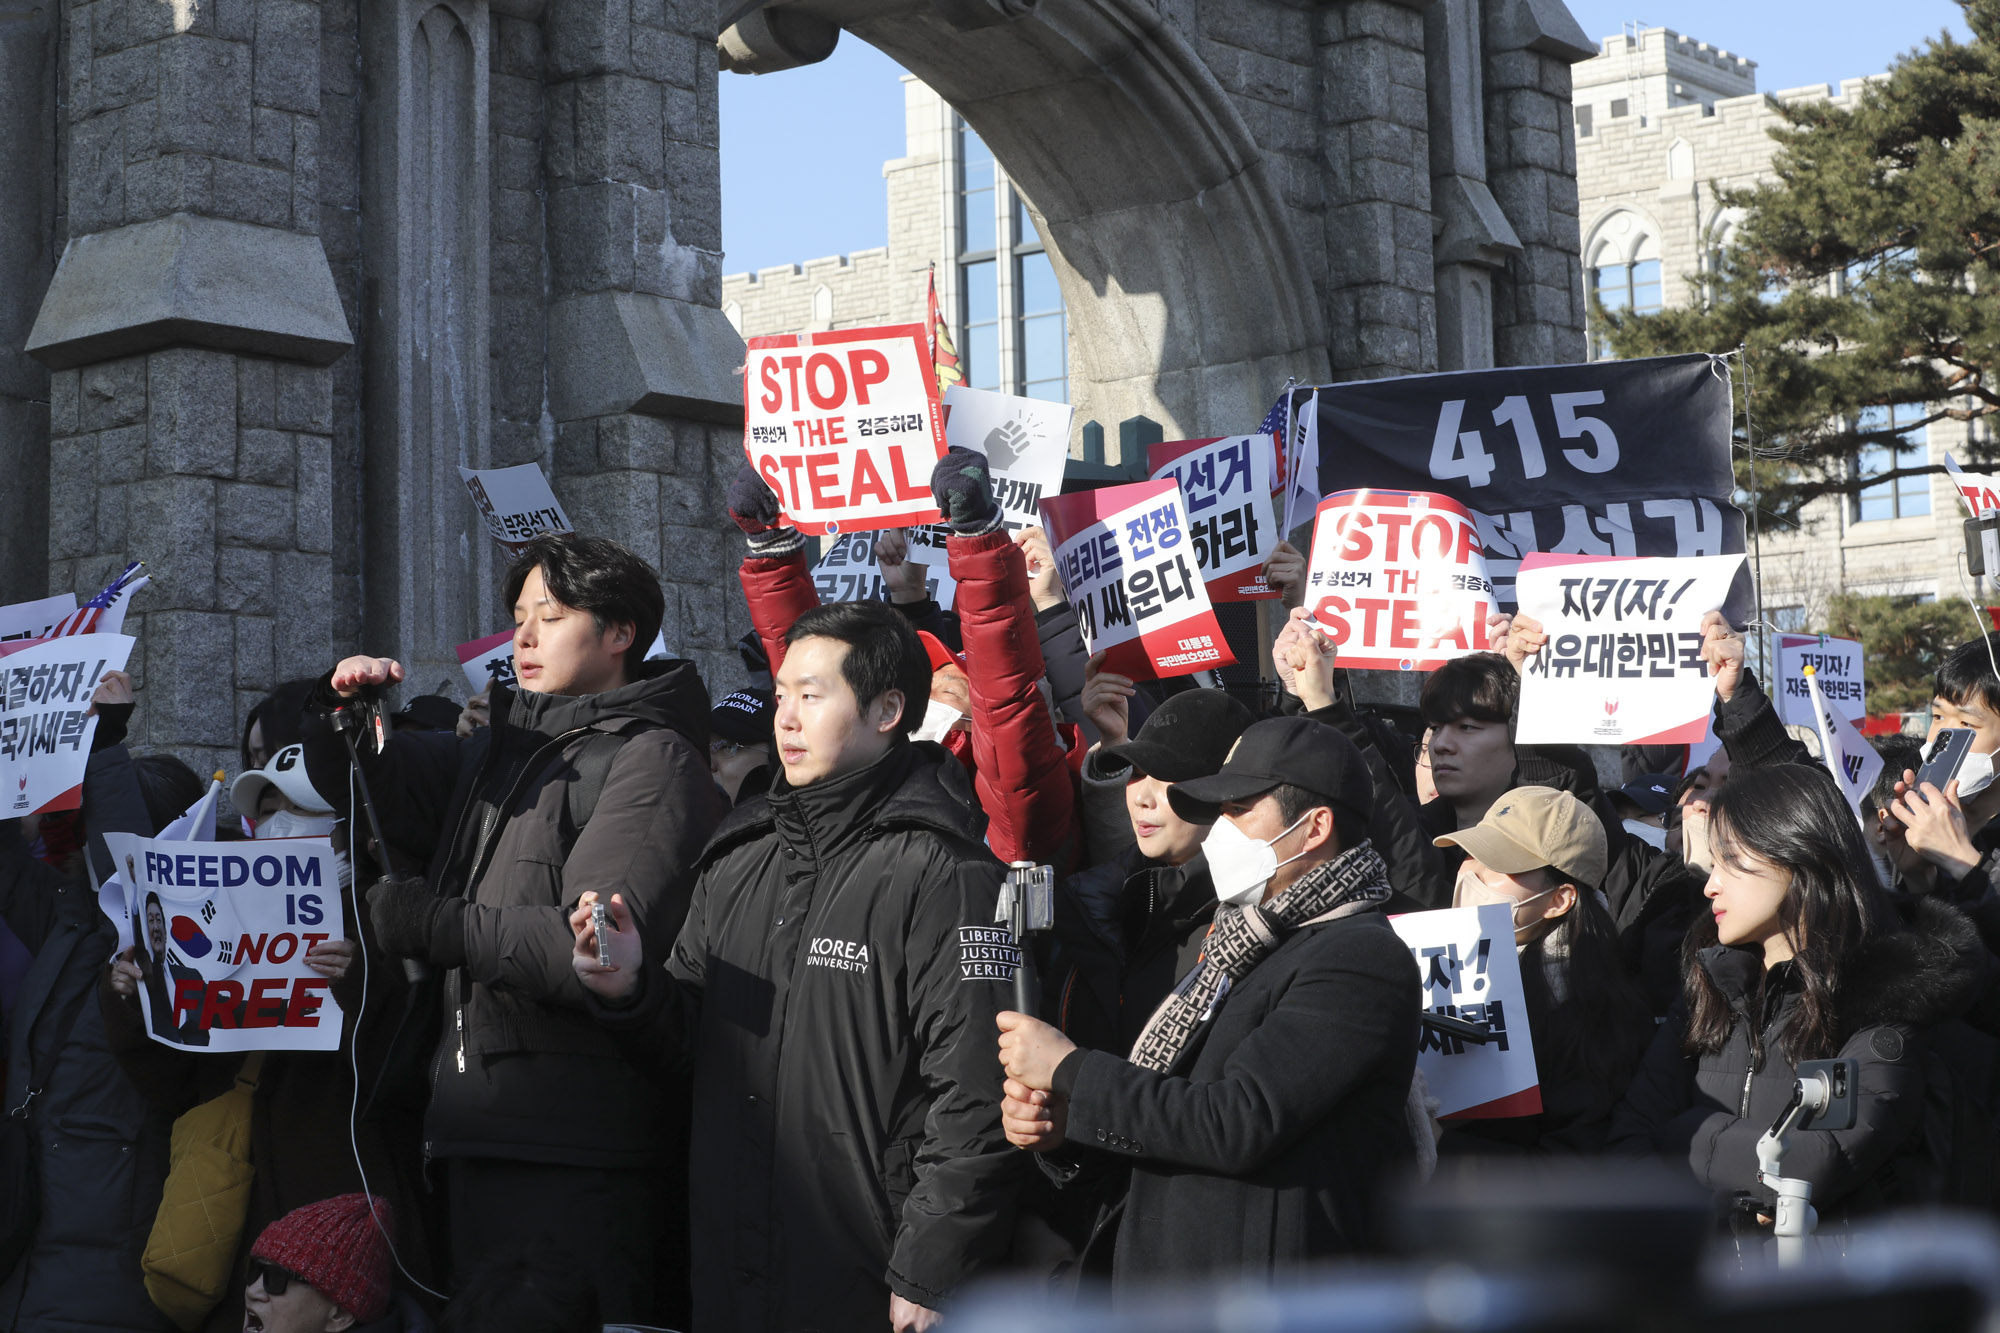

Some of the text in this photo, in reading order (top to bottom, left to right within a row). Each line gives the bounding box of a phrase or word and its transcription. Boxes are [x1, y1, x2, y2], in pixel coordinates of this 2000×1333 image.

[760, 348, 890, 414] STOP
[752, 426, 787, 443] 부정선거
[793, 416, 848, 447] THE
[857, 413, 923, 437] 검증하라
[934, 422, 942, 442] KOREA
[1428, 389, 1621, 488] 415
[760, 445, 932, 511] STEAL
[502, 507, 565, 539] 부정선거
[1126, 502, 1182, 562] 전쟁
[1334, 511, 1485, 564] STOP
[1103, 553, 1195, 630] 싸운다
[1383, 568, 1428, 594] TH
[1451, 575, 1495, 598] 검증하
[1559, 577, 1697, 621] 지키자!
[1156, 648, 1221, 667] 국민변호인단
[1177, 635, 1214, 651] 대통령
[1800, 653, 1851, 677] 지키자!
[727, 701, 757, 714] AGAIN
[731, 692, 764, 708] KOREA
[0, 711, 90, 761] 국가세력
[145, 851, 322, 887] FREEDOM
[286, 894, 324, 925] IS
[232, 933, 330, 965] NOT
[810, 937, 869, 962] KOREA
[807, 956, 868, 974] UNIVERSITY
[1408, 938, 1491, 993] 자!
[172, 978, 329, 1030] FREE
